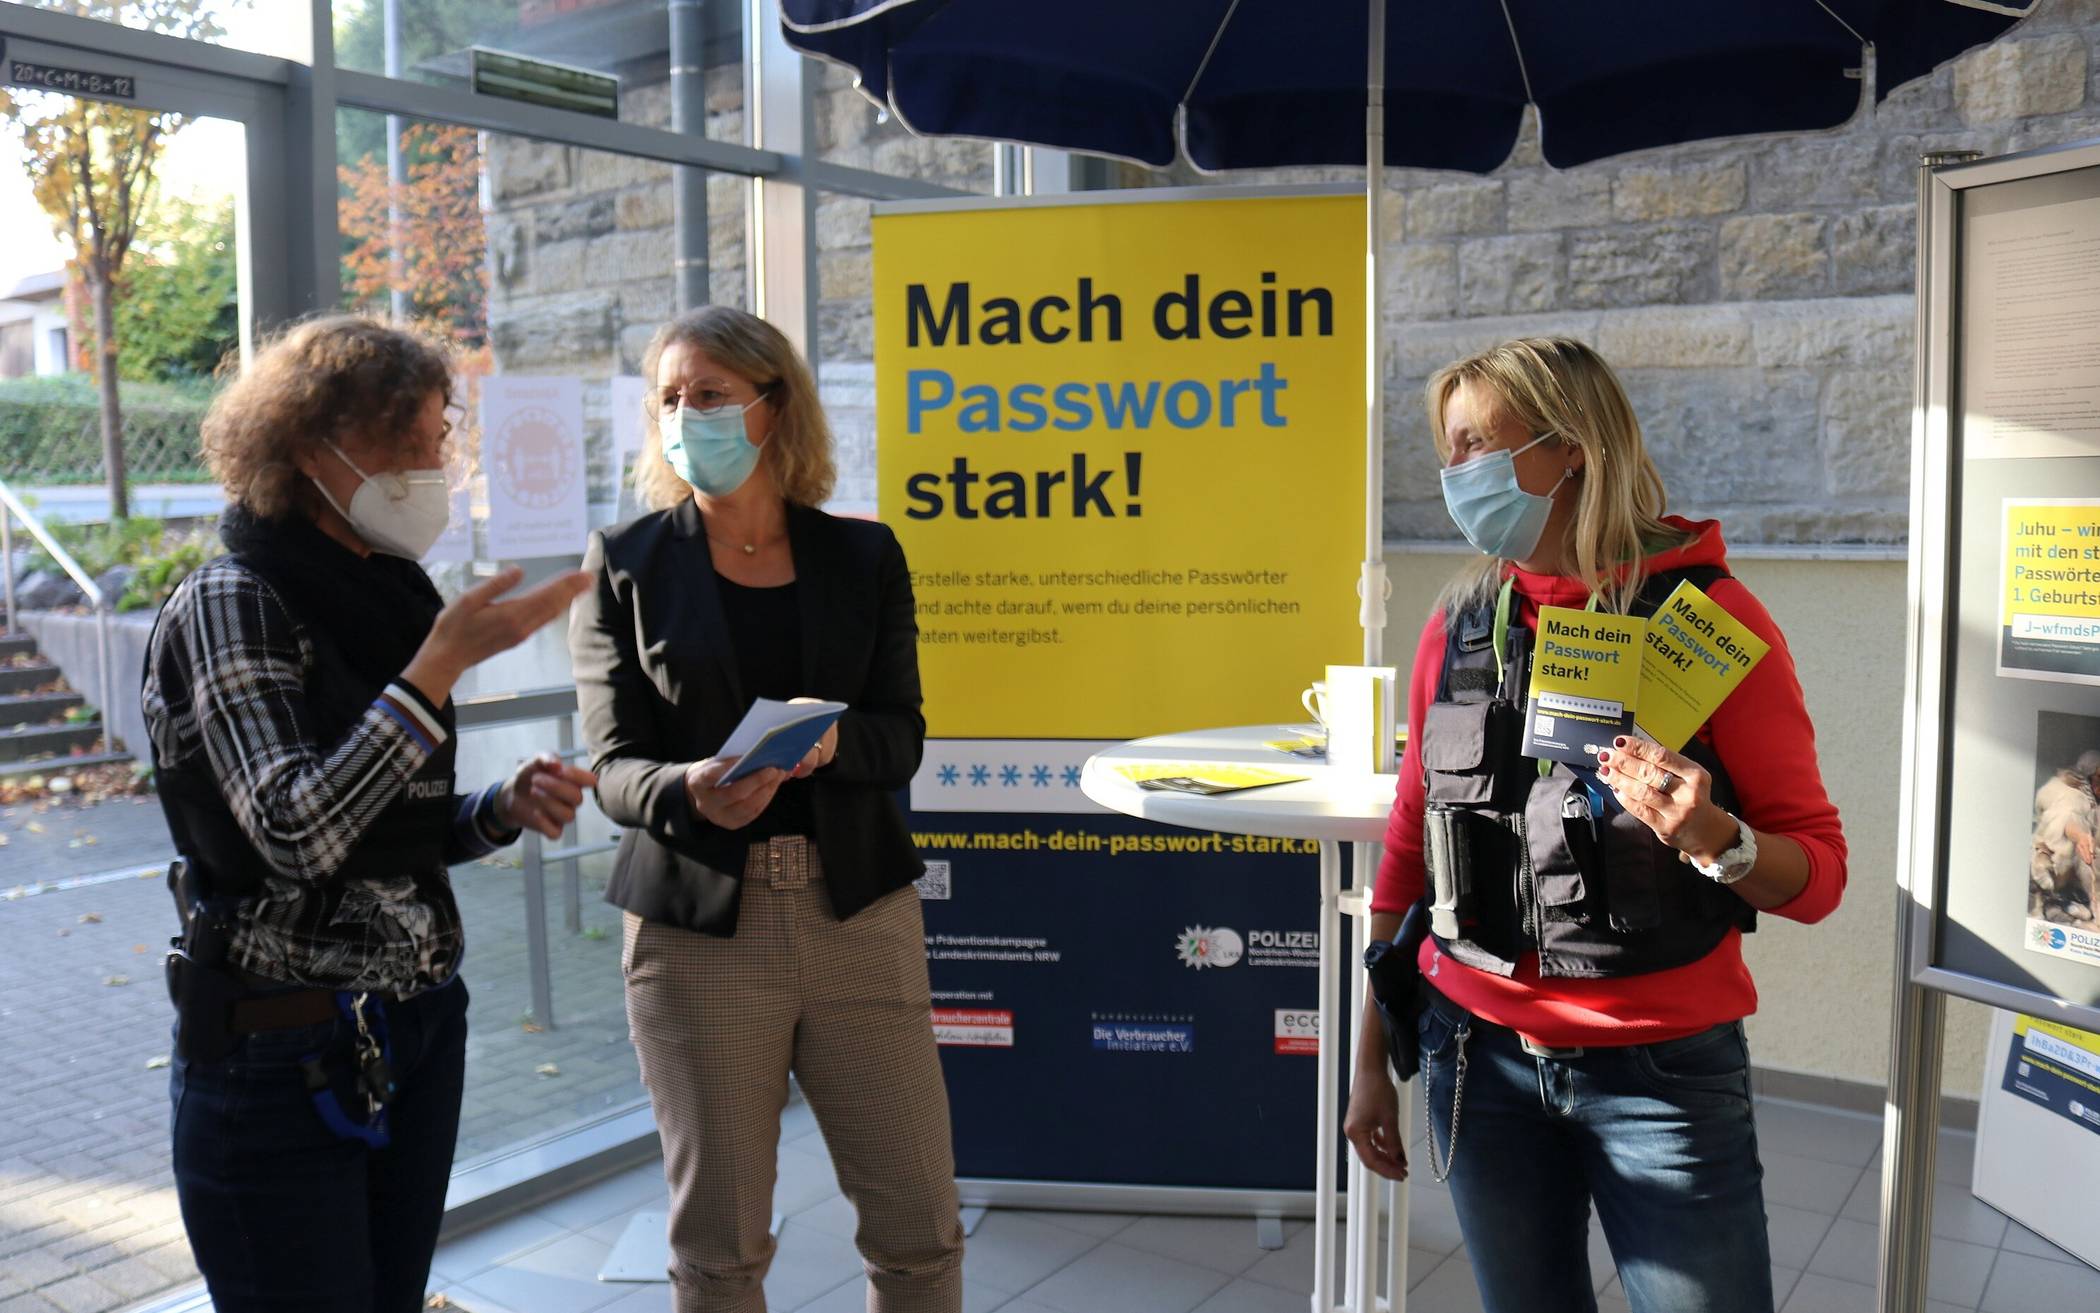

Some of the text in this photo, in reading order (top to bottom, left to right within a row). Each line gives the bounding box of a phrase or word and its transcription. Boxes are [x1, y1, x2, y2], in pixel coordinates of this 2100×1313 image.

[905, 271, 1334, 348] Mach dein
[906, 362, 1289, 434] Passwort
[904, 452, 1142, 520] stark!
[2016, 521, 2056, 536] Juhu
[2015, 544, 2043, 558] mit
[2047, 544, 2078, 559] den
[910, 569, 1289, 587] Erstelle starke, unterschiedliche Passwörter
[2015, 565, 2100, 583] Passwörte
[2013, 587, 2100, 606] 1. Geburts
[944, 600, 992, 615] achte
[996, 599, 1056, 616] darauf,
[1062, 602, 1102, 614] wem
[1107, 600, 1129, 614] du
[1133, 599, 1182, 614] deine
[1185, 598, 1301, 617] persönlichen
[917, 628, 1063, 647] aten weitergibst.
[1546, 620, 1631, 644] Mach dein
[1671, 597, 1752, 667] Mach dein
[1543, 640, 1620, 664] Passwort
[1645, 631, 1695, 673] stark!
[1658, 613, 1731, 678] Passwort
[1541, 663, 1589, 681] stark!
[936, 935, 1047, 949] Präventionskampagne
[1248, 930, 1319, 948] POLIZEI
[933, 950, 1033, 961] Landeskriminalamts
[1035, 951, 1061, 962] NRW
[1093, 1027, 1186, 1042] Die Verbraucher
